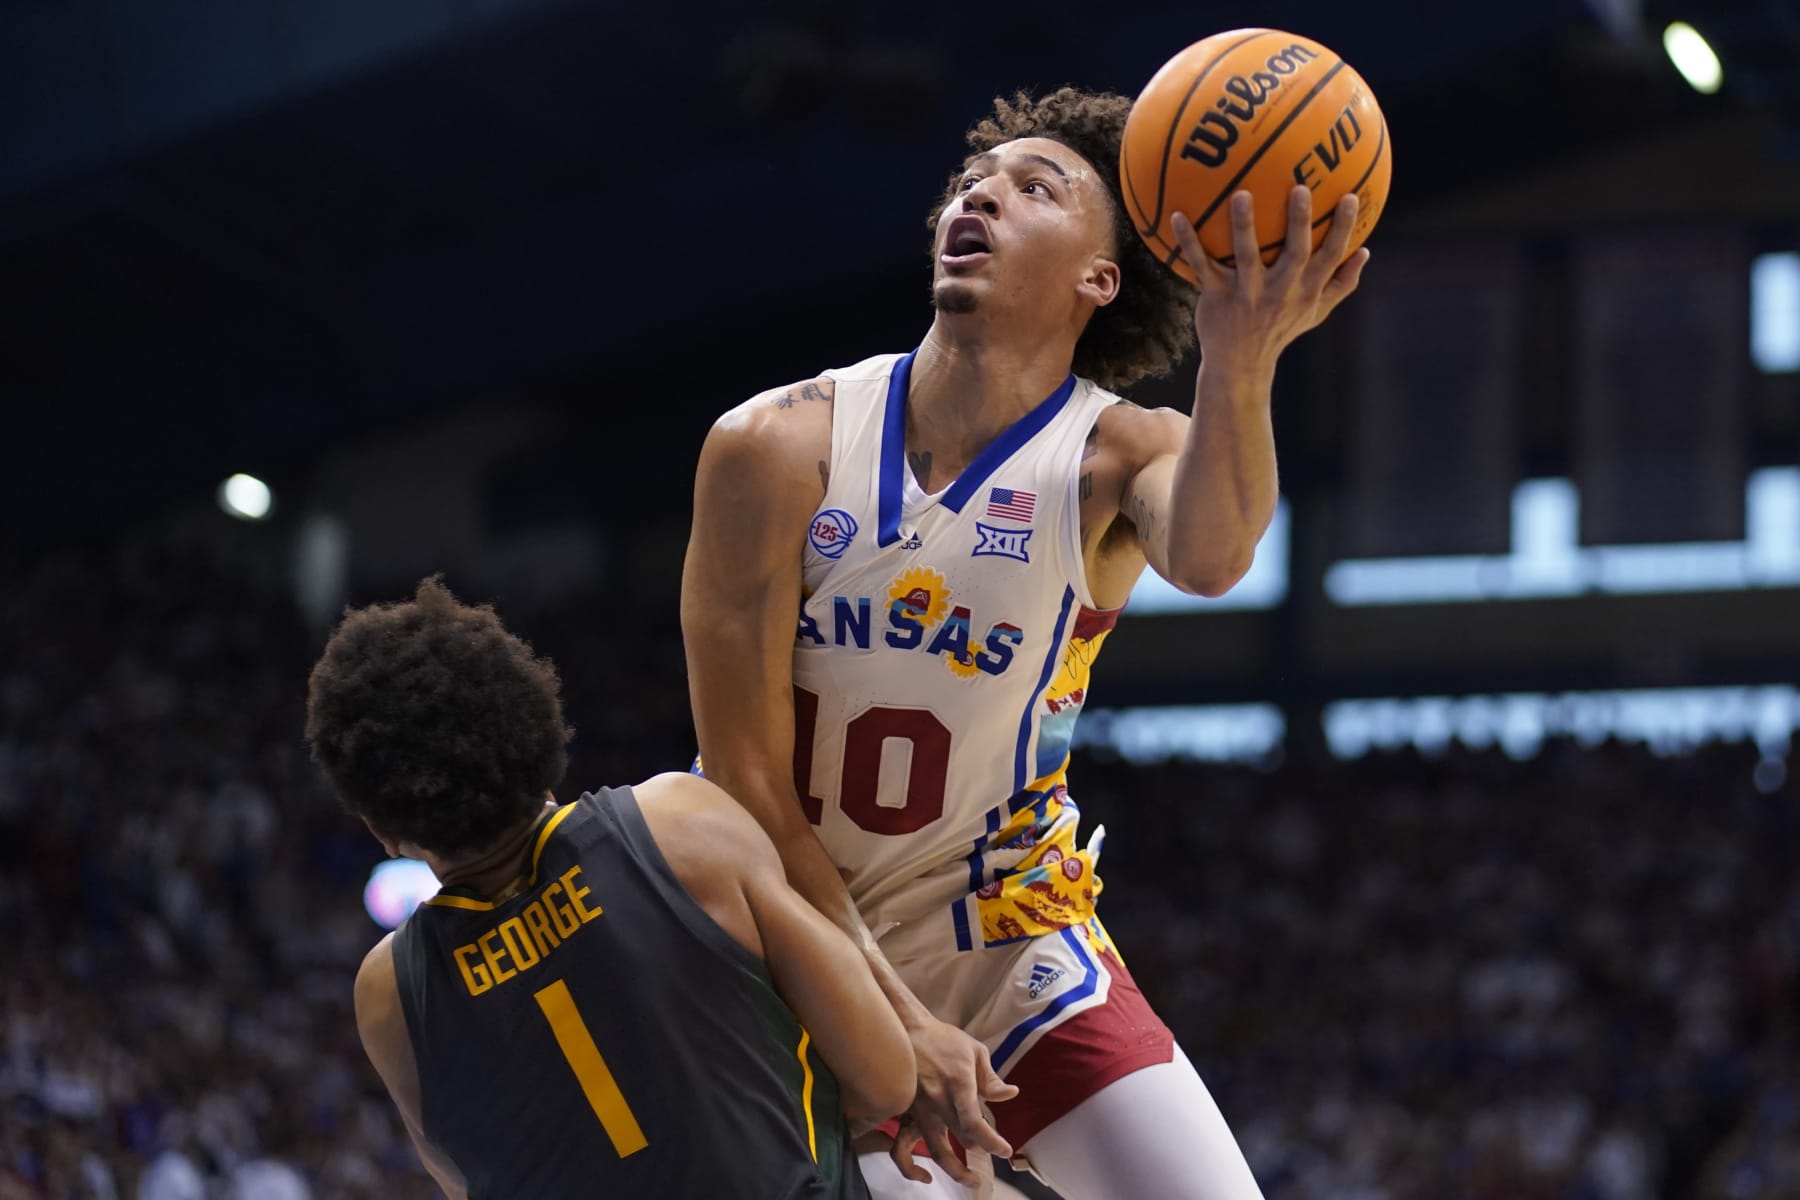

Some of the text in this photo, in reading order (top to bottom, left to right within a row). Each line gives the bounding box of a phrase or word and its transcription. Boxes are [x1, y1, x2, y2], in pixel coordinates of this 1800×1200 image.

[1180, 43, 1319, 169] Wilson
[1293, 107, 1362, 192] EVO
[813, 521, 838, 542] 125
[796, 596, 1024, 676] ANSAS
[792, 683, 952, 836] 10
[453, 865, 603, 996] GEORGE
[1029, 970, 1065, 999] adidas
[533, 978, 648, 1158] 1
